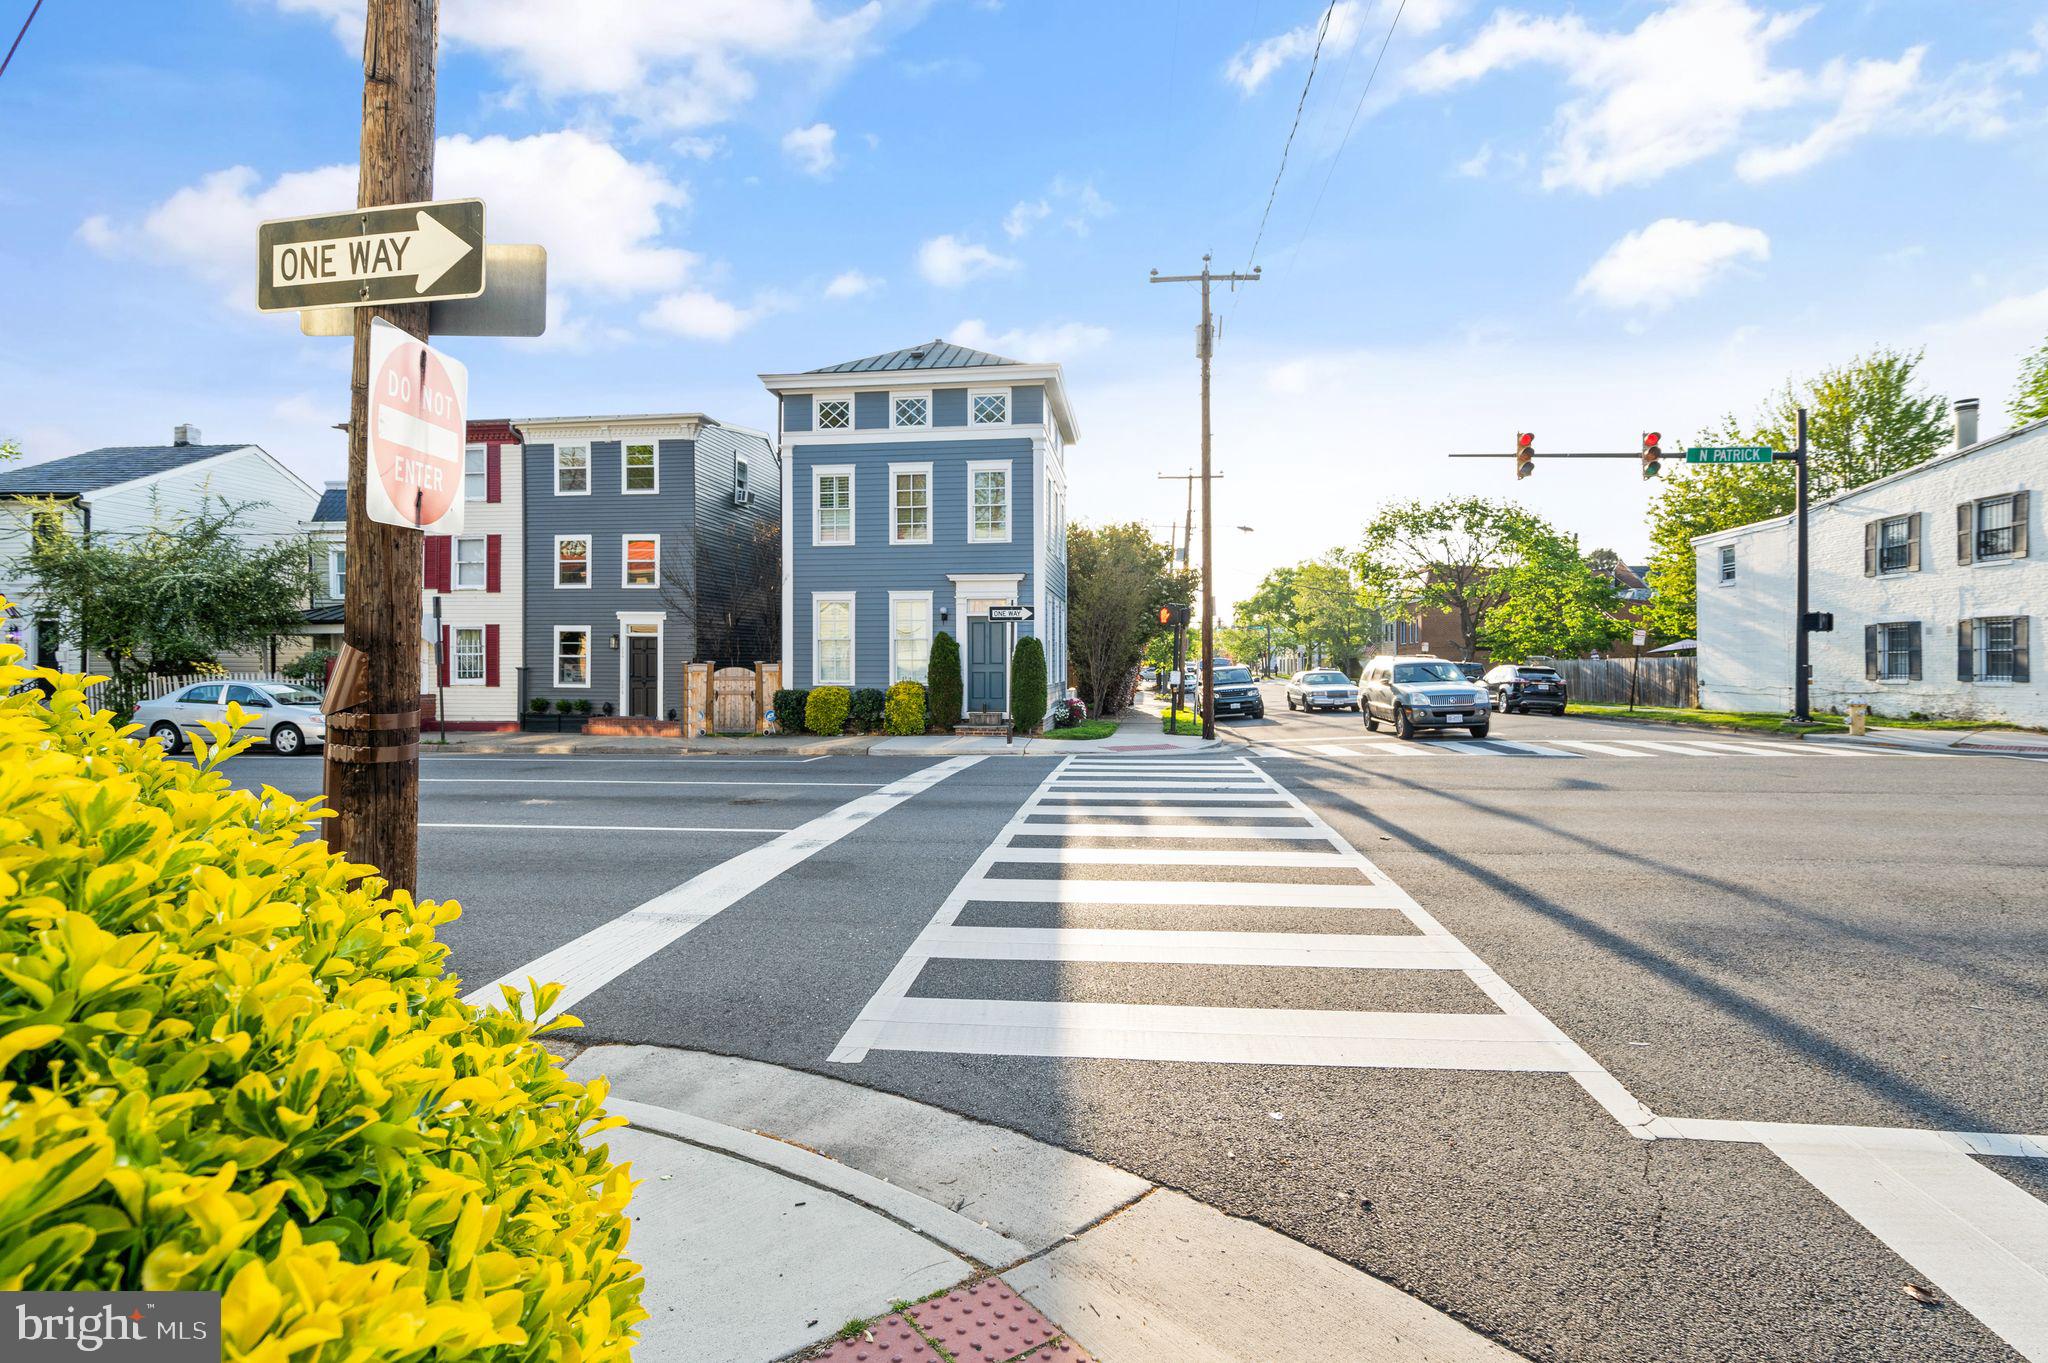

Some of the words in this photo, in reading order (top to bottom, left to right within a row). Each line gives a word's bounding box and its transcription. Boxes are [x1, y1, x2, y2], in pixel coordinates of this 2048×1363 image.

[281, 244, 336, 281] ONE
[348, 236, 411, 275] WAY
[388, 369, 411, 403] DO
[423, 384, 453, 420] NOT
[395, 455, 443, 493] ENTER
[1700, 449, 1708, 462] N
[1713, 449, 1760, 461] PATRICK
